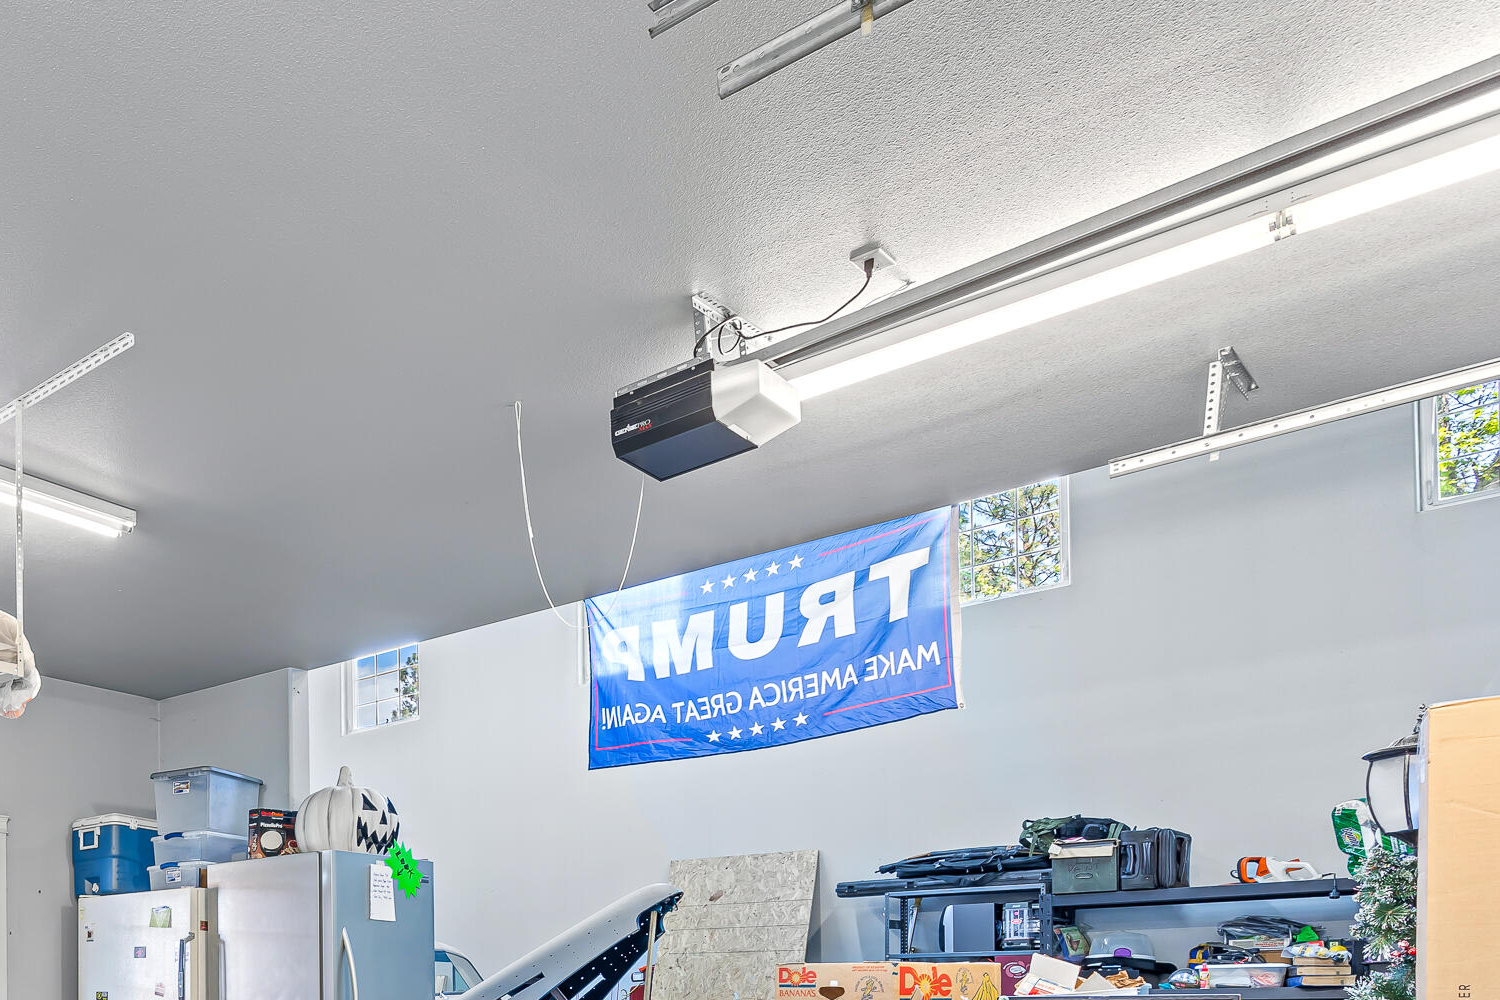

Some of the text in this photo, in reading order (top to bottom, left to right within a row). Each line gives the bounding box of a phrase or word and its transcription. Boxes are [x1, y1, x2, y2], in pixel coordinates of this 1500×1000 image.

[778, 966, 818, 986] Dole
[899, 966, 953, 998] Dole
[779, 989, 817, 998] BANANAS
